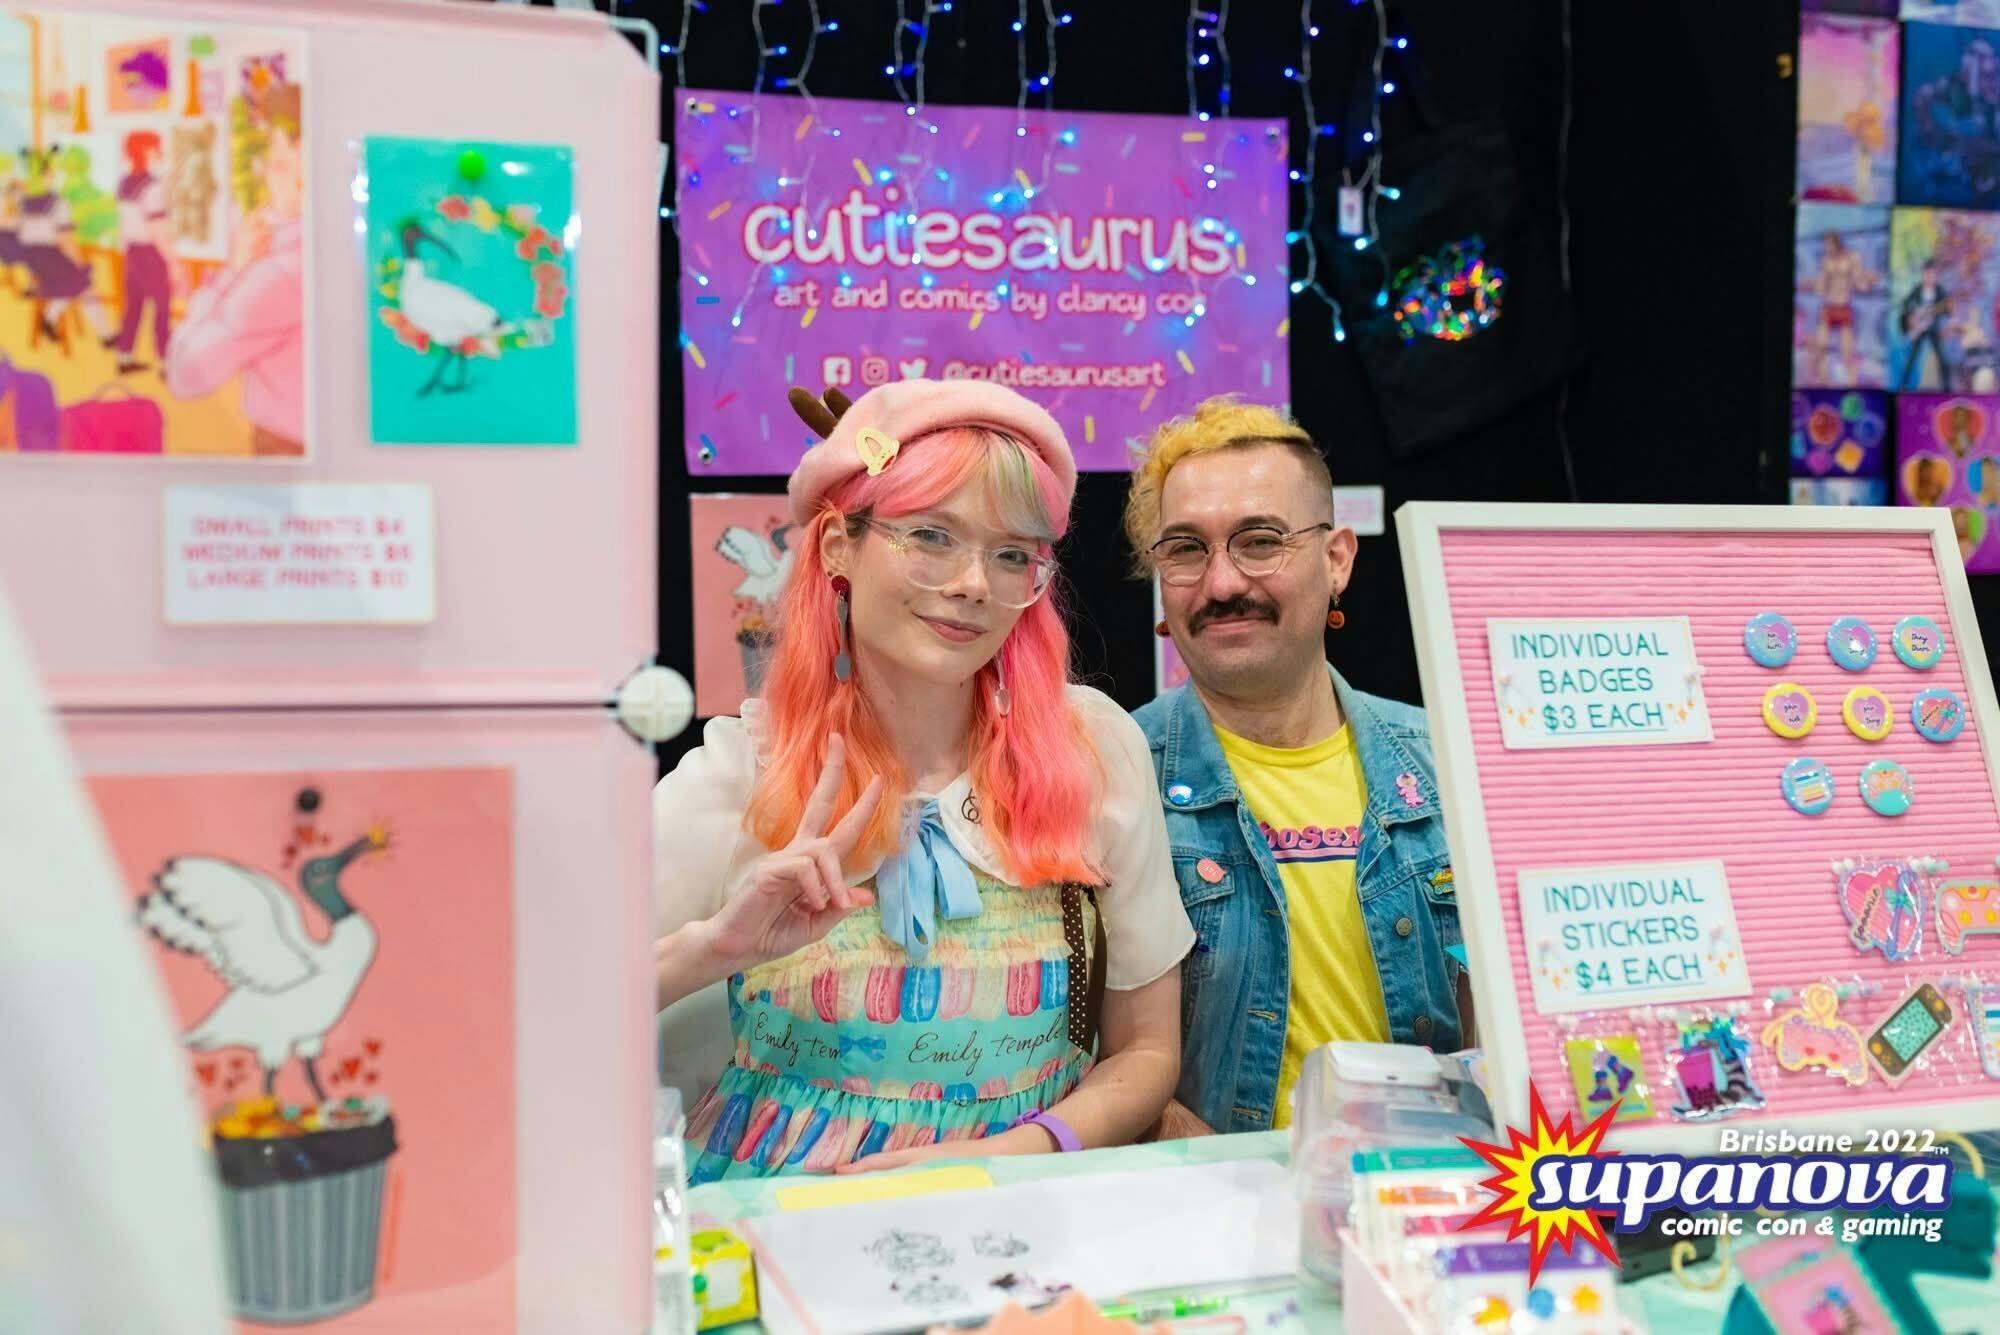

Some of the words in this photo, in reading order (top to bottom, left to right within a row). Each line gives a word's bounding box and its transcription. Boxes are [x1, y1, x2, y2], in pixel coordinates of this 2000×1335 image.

[743, 186, 1234, 275] cutiesaurus
[773, 281, 821, 307] art
[831, 278, 888, 308] and
[899, 282, 1001, 312] comics
[1010, 281, 1048, 320] by
[280, 515, 363, 536] PRINTS
[291, 541, 373, 562] PRINTS
[276, 566, 358, 588] PRINTS
[1511, 631, 1669, 659] INDIVIDUAL
[1537, 667, 1654, 694] BADGES
[1542, 703, 1577, 731] $3
[1587, 702, 1665, 729] EACH
[1543, 877, 1705, 913] INDIVIDUAL
[1561, 915, 1699, 951] STICKERS
[1575, 960, 1612, 990] $4
[1622, 953, 1703, 985] EACH
[754, 1012, 801, 1067] Emily
[907, 1030, 984, 1075] Emily
